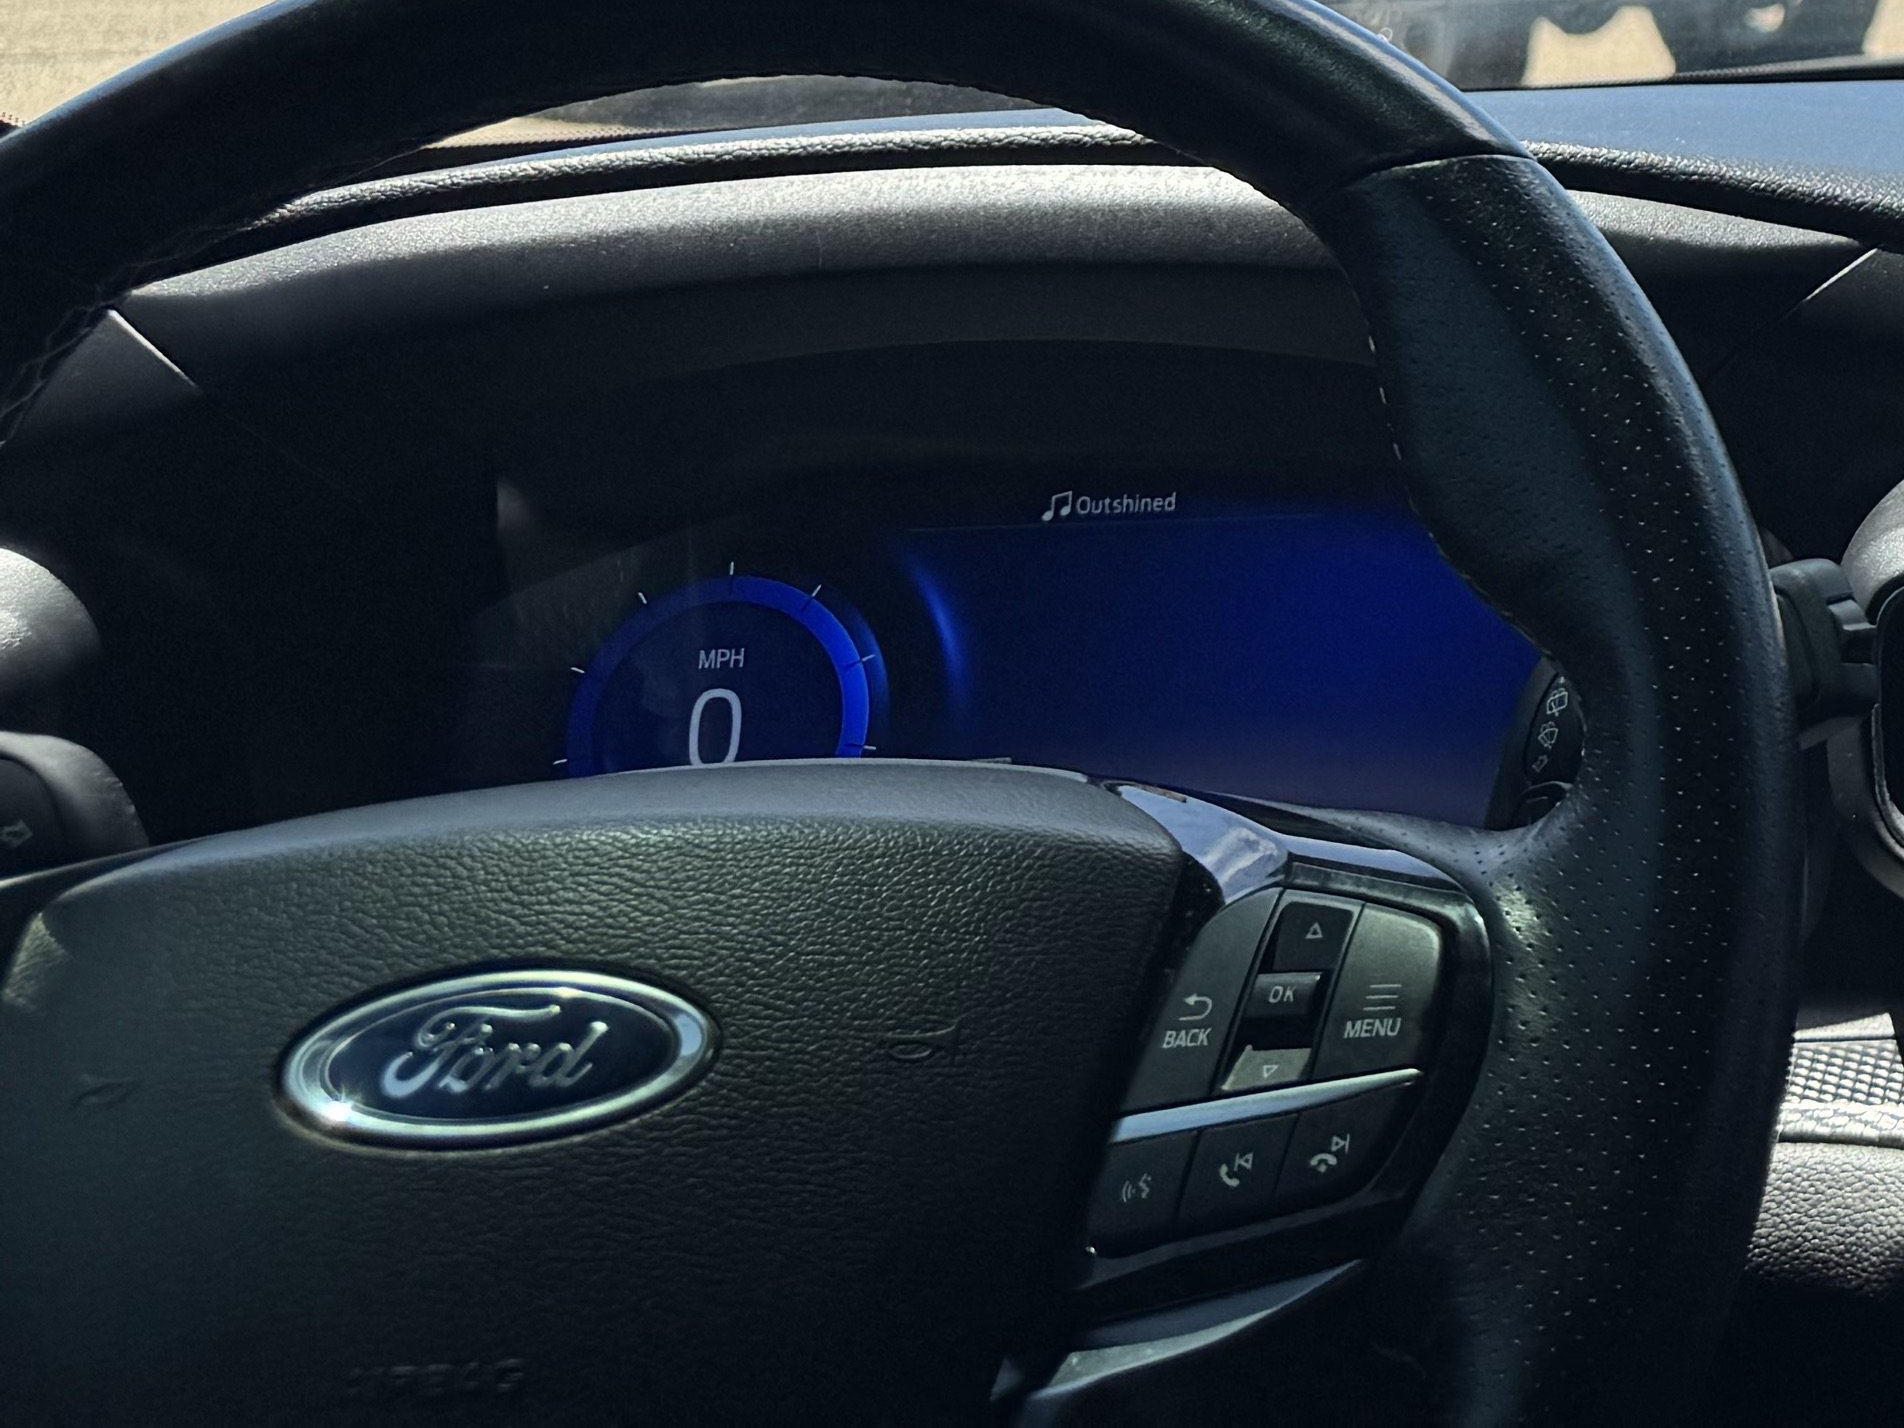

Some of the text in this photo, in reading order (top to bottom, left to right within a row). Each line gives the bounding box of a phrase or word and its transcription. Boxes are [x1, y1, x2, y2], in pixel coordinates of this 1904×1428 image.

[1074, 489, 1177, 518] Outshined
[697, 646, 746, 671] MPH
[688, 688, 742, 766] 0
[1268, 984, 1297, 1004] OK
[1162, 1027, 1211, 1050] BACK
[1343, 1017, 1402, 1041] MENU
[380, 1004, 611, 1098] Ford
